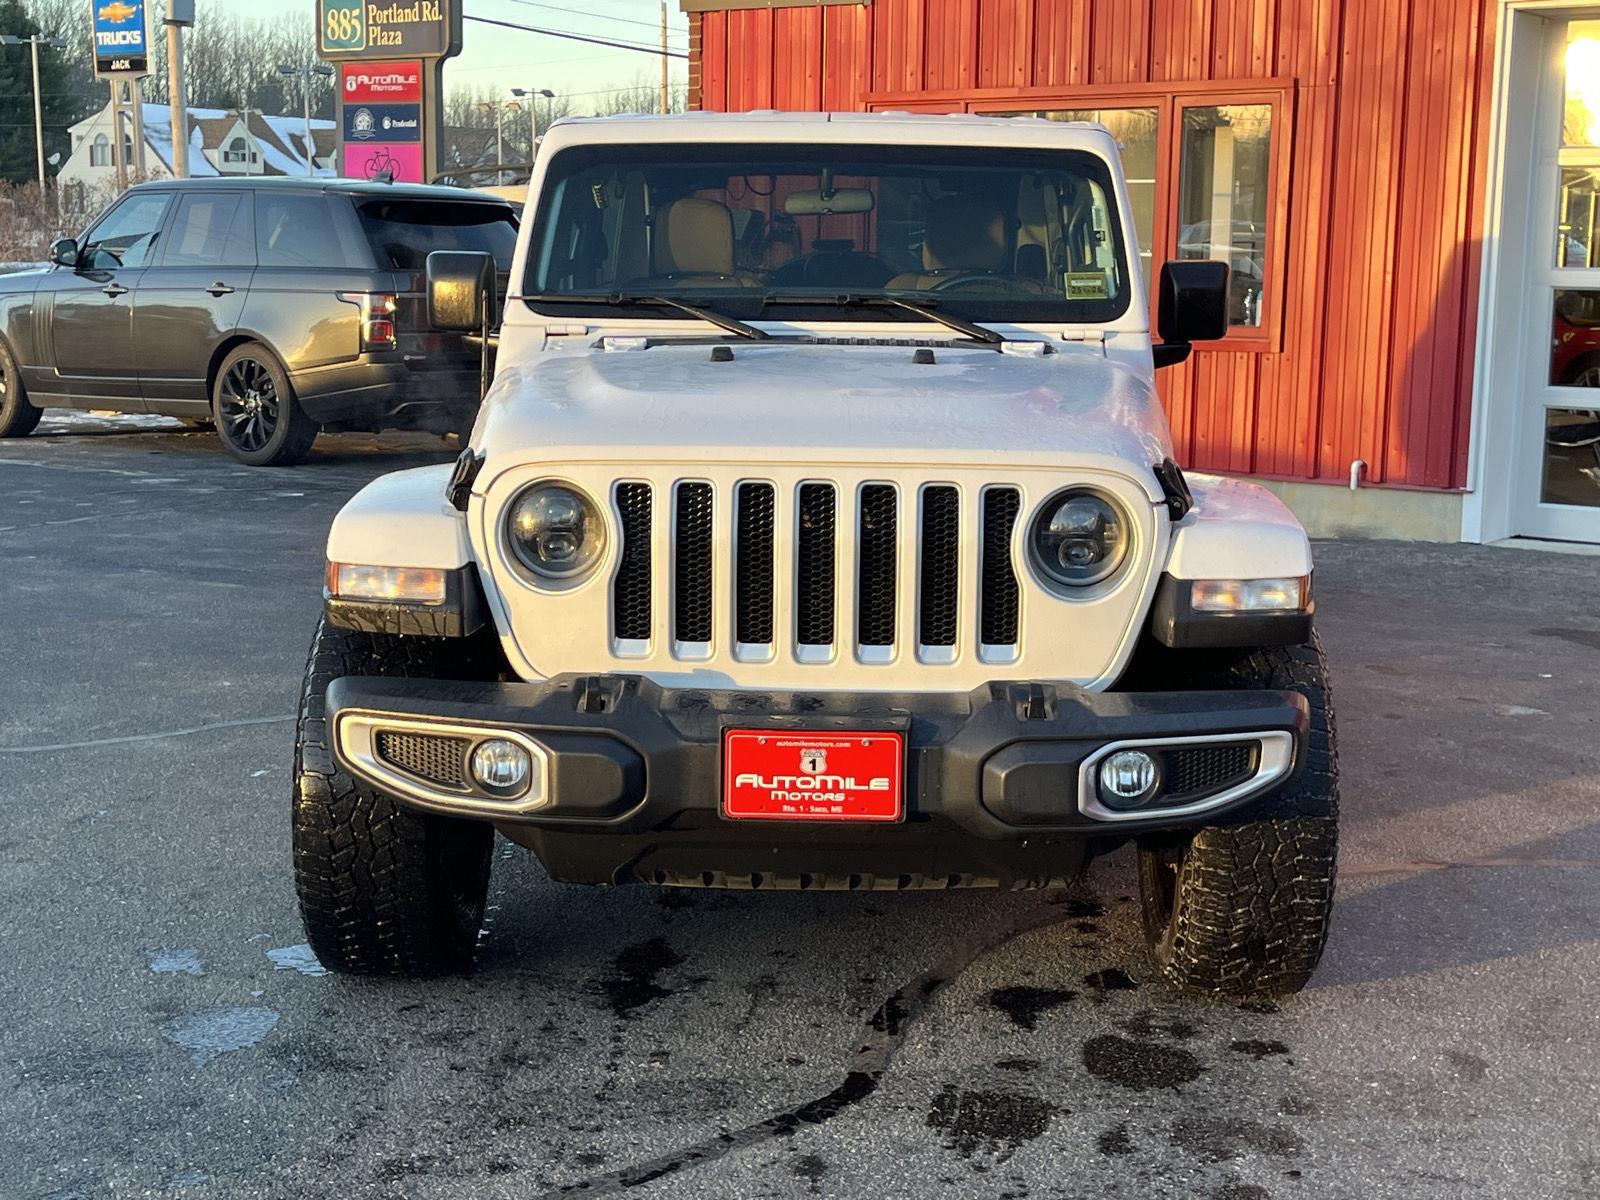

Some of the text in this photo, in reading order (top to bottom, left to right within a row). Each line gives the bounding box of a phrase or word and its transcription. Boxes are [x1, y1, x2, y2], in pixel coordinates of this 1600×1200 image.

[367, 0, 443, 25] Portland Rd.
[327, 8, 362, 43] 885
[96, 30, 142, 46] TRUCKS
[368, 26, 402, 46] Plaza
[110, 60, 131, 70] JACK
[808, 758, 817, 771] 1
[782, 804, 798, 813] Rte.
[831, 804, 844, 813] ME
